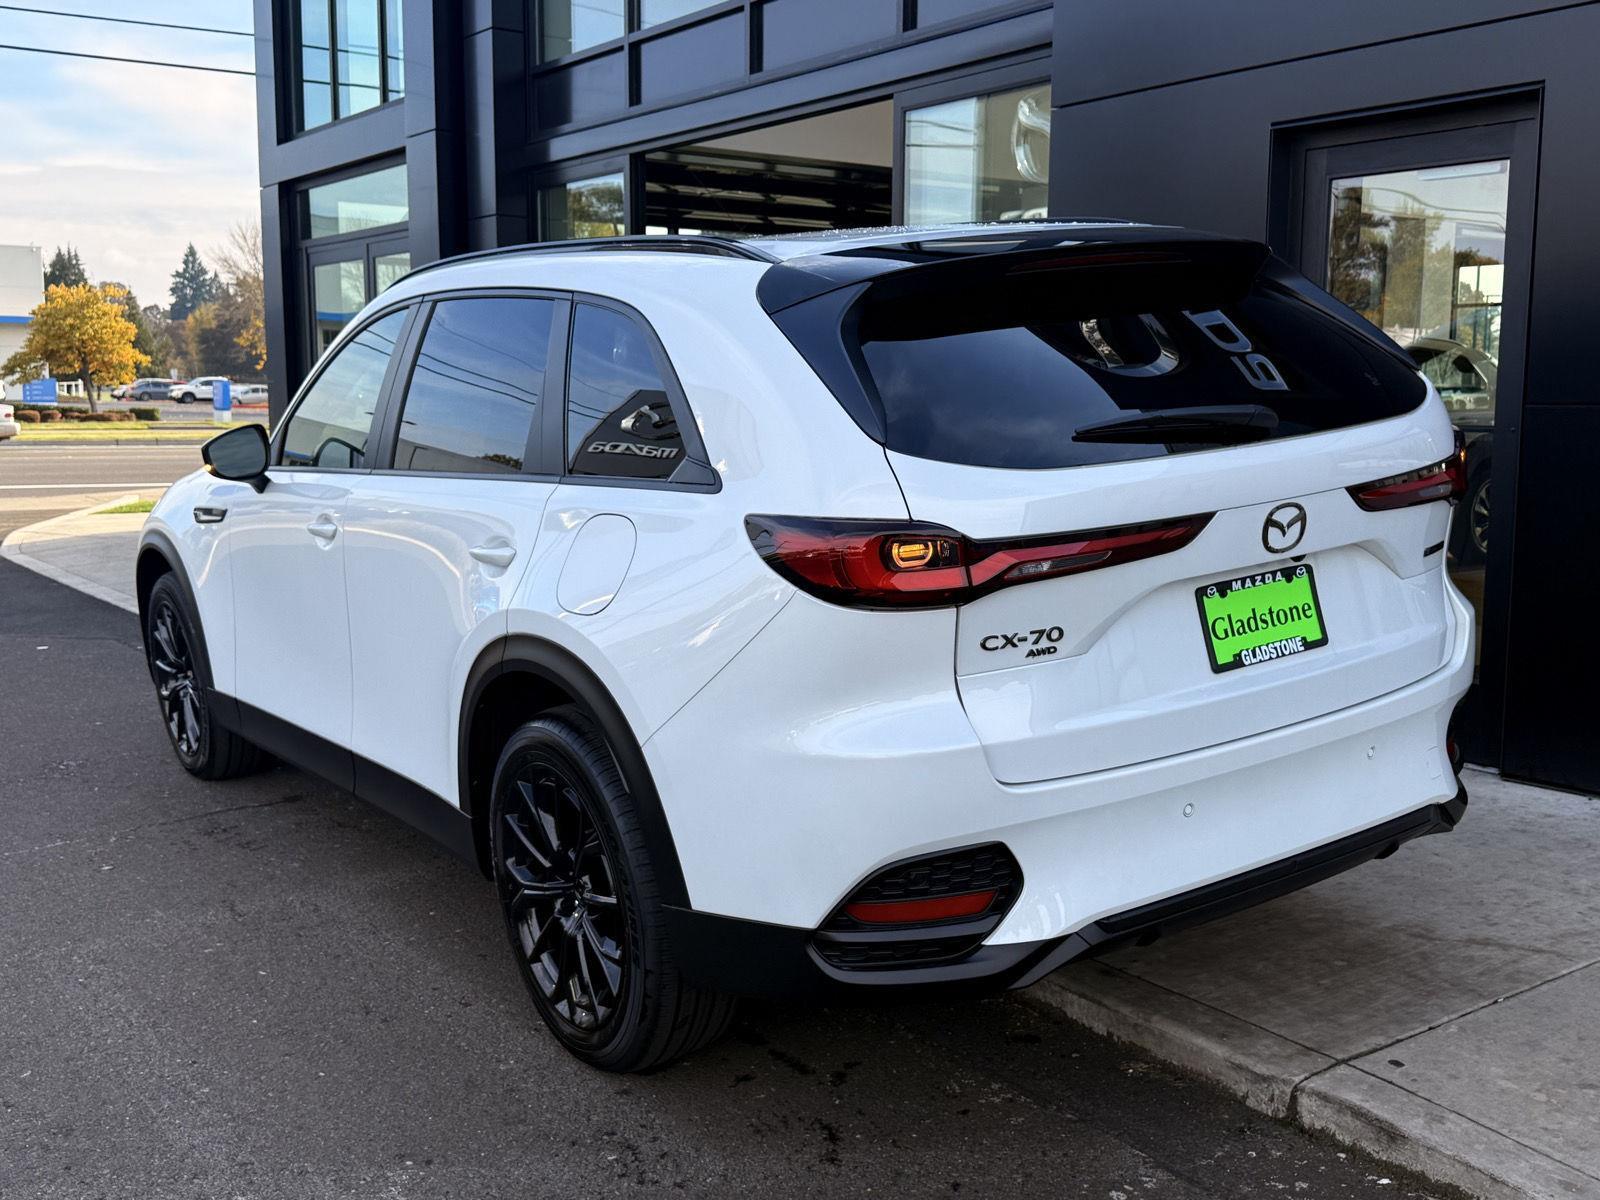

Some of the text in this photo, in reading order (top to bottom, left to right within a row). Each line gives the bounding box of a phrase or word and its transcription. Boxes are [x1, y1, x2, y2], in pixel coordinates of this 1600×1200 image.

[1231, 571, 1284, 591] MAZDA
[1211, 601, 1313, 641] Gladstone
[980, 626, 1064, 651] CX-70
[1025, 646, 1057, 658] AWD
[1241, 637, 1305, 666] GLADSTONE
